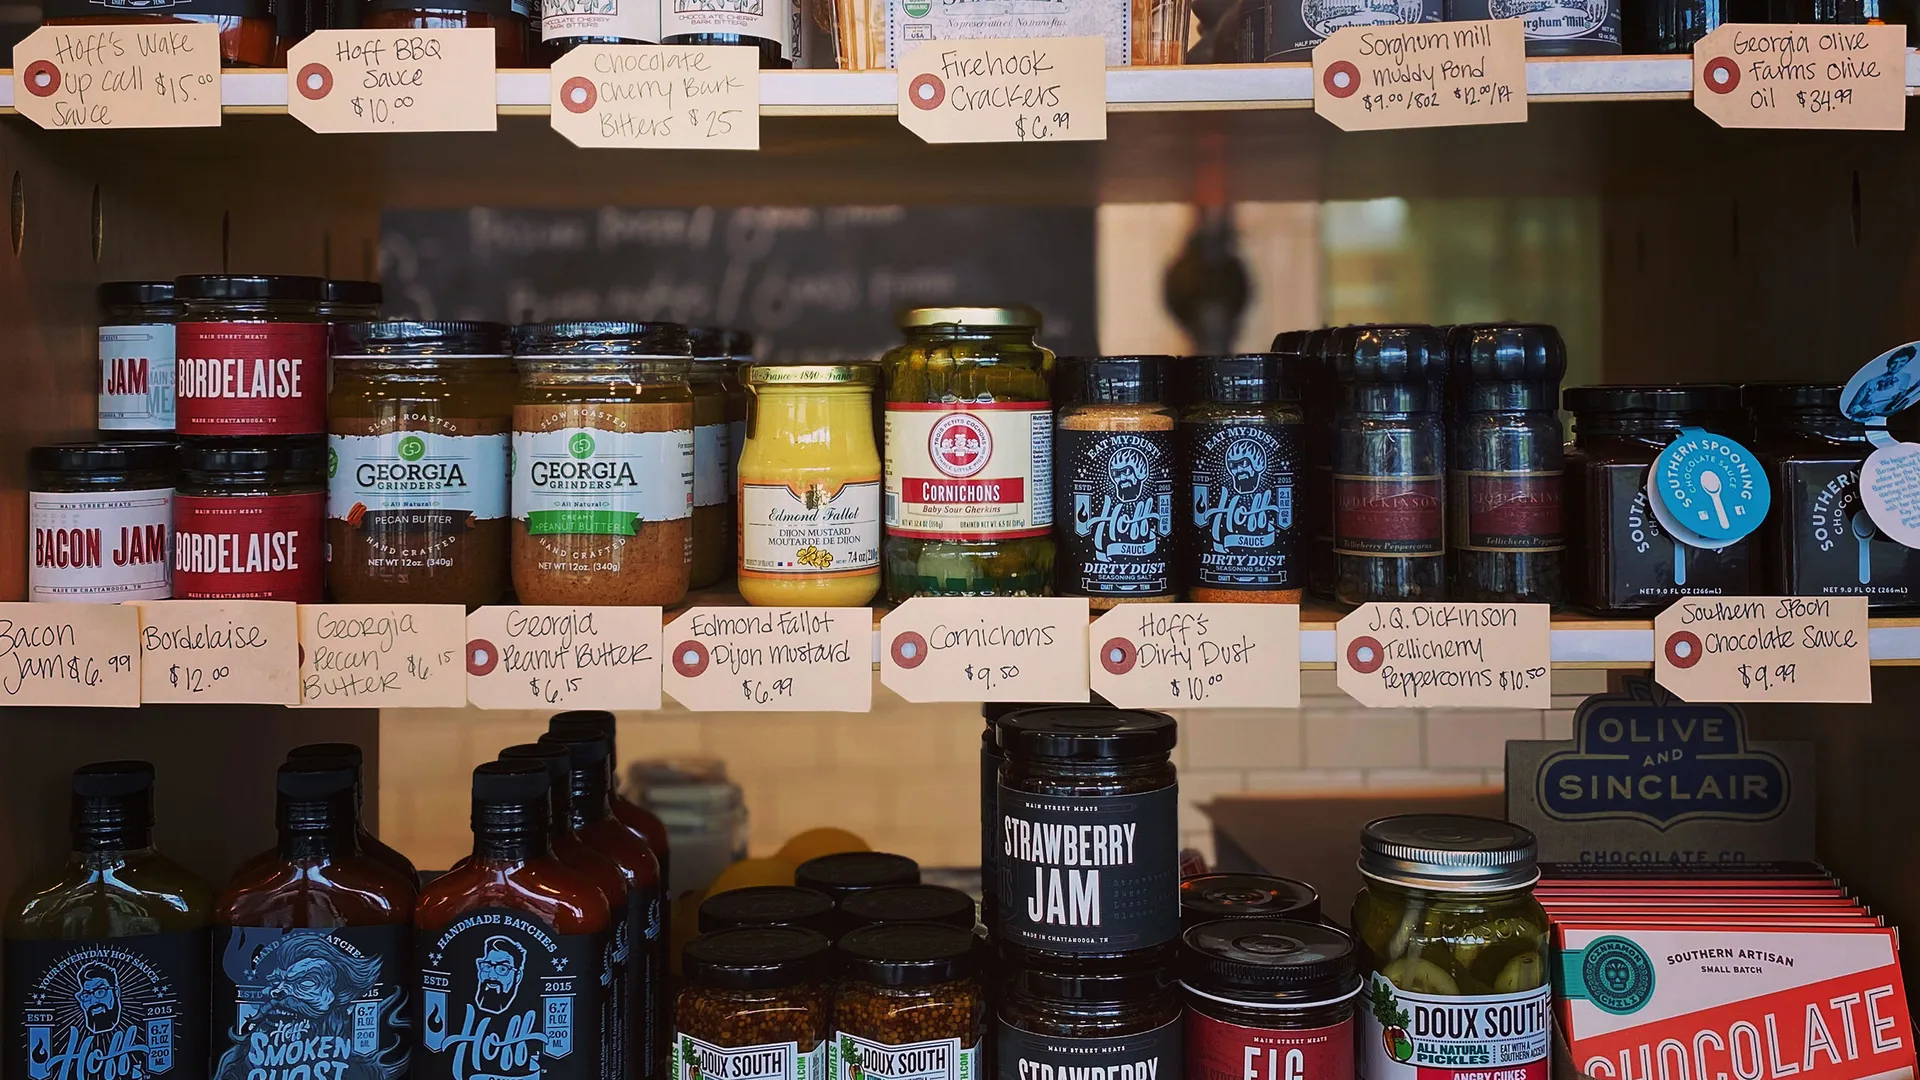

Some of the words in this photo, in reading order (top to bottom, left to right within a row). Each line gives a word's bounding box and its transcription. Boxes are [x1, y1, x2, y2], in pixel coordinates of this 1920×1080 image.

[947, 20, 958, 28] No
[1017, 19, 1028, 28] No
[55, 31, 125, 64] Hoff's
[136, 31, 195, 56] Wake
[336, 39, 385, 65] Hoff
[394, 39, 443, 61] BBQ
[1358, 34, 1451, 66] Sorghum
[1733, 32, 1810, 67] Georgia
[940, 48, 1055, 80] Firehook
[1749, 61, 1818, 82] Farms
[155, 74, 214, 103] $15.00
[684, 75, 745, 98] Bark
[950, 82, 1060, 111] Crackers
[351, 96, 414, 126] $10.00
[1796, 88, 1854, 114] $34.99
[600, 111, 673, 139] Bitters
[689, 107, 744, 138] $25
[1015, 111, 1070, 142] $6.99
[107, 358, 149, 395] JAM
[178, 358, 303, 399] BORDELAISE
[368, 415, 397, 433] SLOW
[403, 413, 458, 432] ROASTED
[1087, 439, 1109, 460] EAT
[1111, 435, 1129, 444] MY
[356, 463, 467, 488] GEORGIA
[377, 481, 442, 490] GRINDERS
[531, 461, 638, 487] GEORGIA
[549, 481, 612, 489] GRINDERS
[1668, 441, 1699, 508] SOUTHERN
[1702, 440, 1753, 500] SPOONING
[1684, 454, 1716, 493] CHOCOLATE
[1718, 460, 1736, 489] SAUCE
[922, 481, 1000, 502] CORNICHONS
[375, 515, 410, 525] PECAN
[412, 515, 452, 524] BUTTER
[768, 508, 819, 522] Edmond
[823, 507, 859, 521] Fallot
[923, 505, 942, 514] Baby
[965, 505, 1001, 514] Gherkins
[1086, 495, 1161, 550] Hoff
[538, 522, 575, 532] PEANUT
[578, 522, 621, 532] BUTTER
[779, 529, 803, 537] DIJON
[807, 528, 851, 537] MUSTARD
[35, 528, 102, 569] BACON
[112, 523, 166, 567] JAM
[175, 530, 298, 574] BORDELAISE
[366, 536, 397, 555] HAND
[402, 536, 456, 557] CRAFTED
[768, 537, 820, 546] MOUTARDE
[823, 537, 834, 545] DE
[836, 535, 861, 545] DIJON
[1121, 545, 1147, 554] SAUCE
[1084, 563, 1126, 574] DIRTY
[1130, 563, 1165, 574] DUST
[1202, 554, 1245, 565] DIRTY
[1250, 555, 1285, 566] DUST
[690, 614, 773, 637] Edmond
[779, 611, 835, 635] Fallot
[1368, 608, 1409, 632] J.Q.
[1414, 604, 1518, 629] Dickinson
[1681, 597, 1766, 625] Southern
[1778, 597, 1830, 625] Spoon
[143, 625, 267, 650] Bordelaise
[317, 612, 417, 652] Georgia
[506, 610, 598, 650] Georgia
[930, 624, 1057, 650] Cornichons
[1139, 613, 1210, 640] Hoff's
[1381, 636, 1485, 665] Tellicherry
[1704, 629, 1795, 653] Chocolate
[1802, 628, 1859, 651] Sauce
[407, 649, 455, 679] $6.15
[502, 647, 570, 673] Peanut
[710, 641, 764, 675] Dijon
[1138, 642, 1195, 671] Dirty
[1199, 637, 1256, 666] Dust
[3, 653, 65, 695] Jam
[69, 653, 131, 685] $6.99
[169, 664, 229, 693] $12.00
[964, 664, 1020, 689] $9.50
[1381, 665, 1493, 697] Peppercorns
[1498, 665, 1546, 691] $10.50
[1738, 661, 1797, 688] $9.99
[530, 677, 582, 704] $6.15
[742, 677, 794, 704] $6.99
[1171, 674, 1222, 702] $10.00
[1599, 718, 1724, 743] OLIVE
[1643, 749, 1682, 767] AND
[1559, 775, 1768, 800] SINCLAIR
[1005, 815, 1136, 866] STRAWBERRY
[1028, 867, 1100, 925] JAM
[437, 915, 501, 950] HANDMADE
[504, 916, 557, 953] BATCHES
[1590, 943, 1642, 963] CINNAMON
[1667, 949, 1733, 965] SOUTHERN
[1739, 949, 1794, 967] ARTISAN
[39, 967, 59, 990] YOUR
[59, 950, 110, 968] EVERYDAY
[110, 951, 132, 962] HOT
[133, 958, 159, 983] SAUCE
[1733, 966, 1762, 974] BATCH
[147, 1006, 172, 1015] 2015
[1601, 995, 1639, 1007] CHILI
[1415, 1006, 1478, 1038] DOUX
[1485, 1000, 1545, 1038] SOUTH
[45, 1026, 150, 1080] Hoff
[250, 1032, 351, 1066] SMOKEN
[442, 1004, 549, 1080] Hoff
[1418, 1043, 1437, 1053] ALL
[1440, 1044, 1489, 1055] NATURAL
[702, 1051, 728, 1076] DOUX
[732, 1051, 782, 1076] SOUTH
[1418, 1055, 1489, 1064] PICKLES
[1498, 1069, 1526, 1080] CUKES
